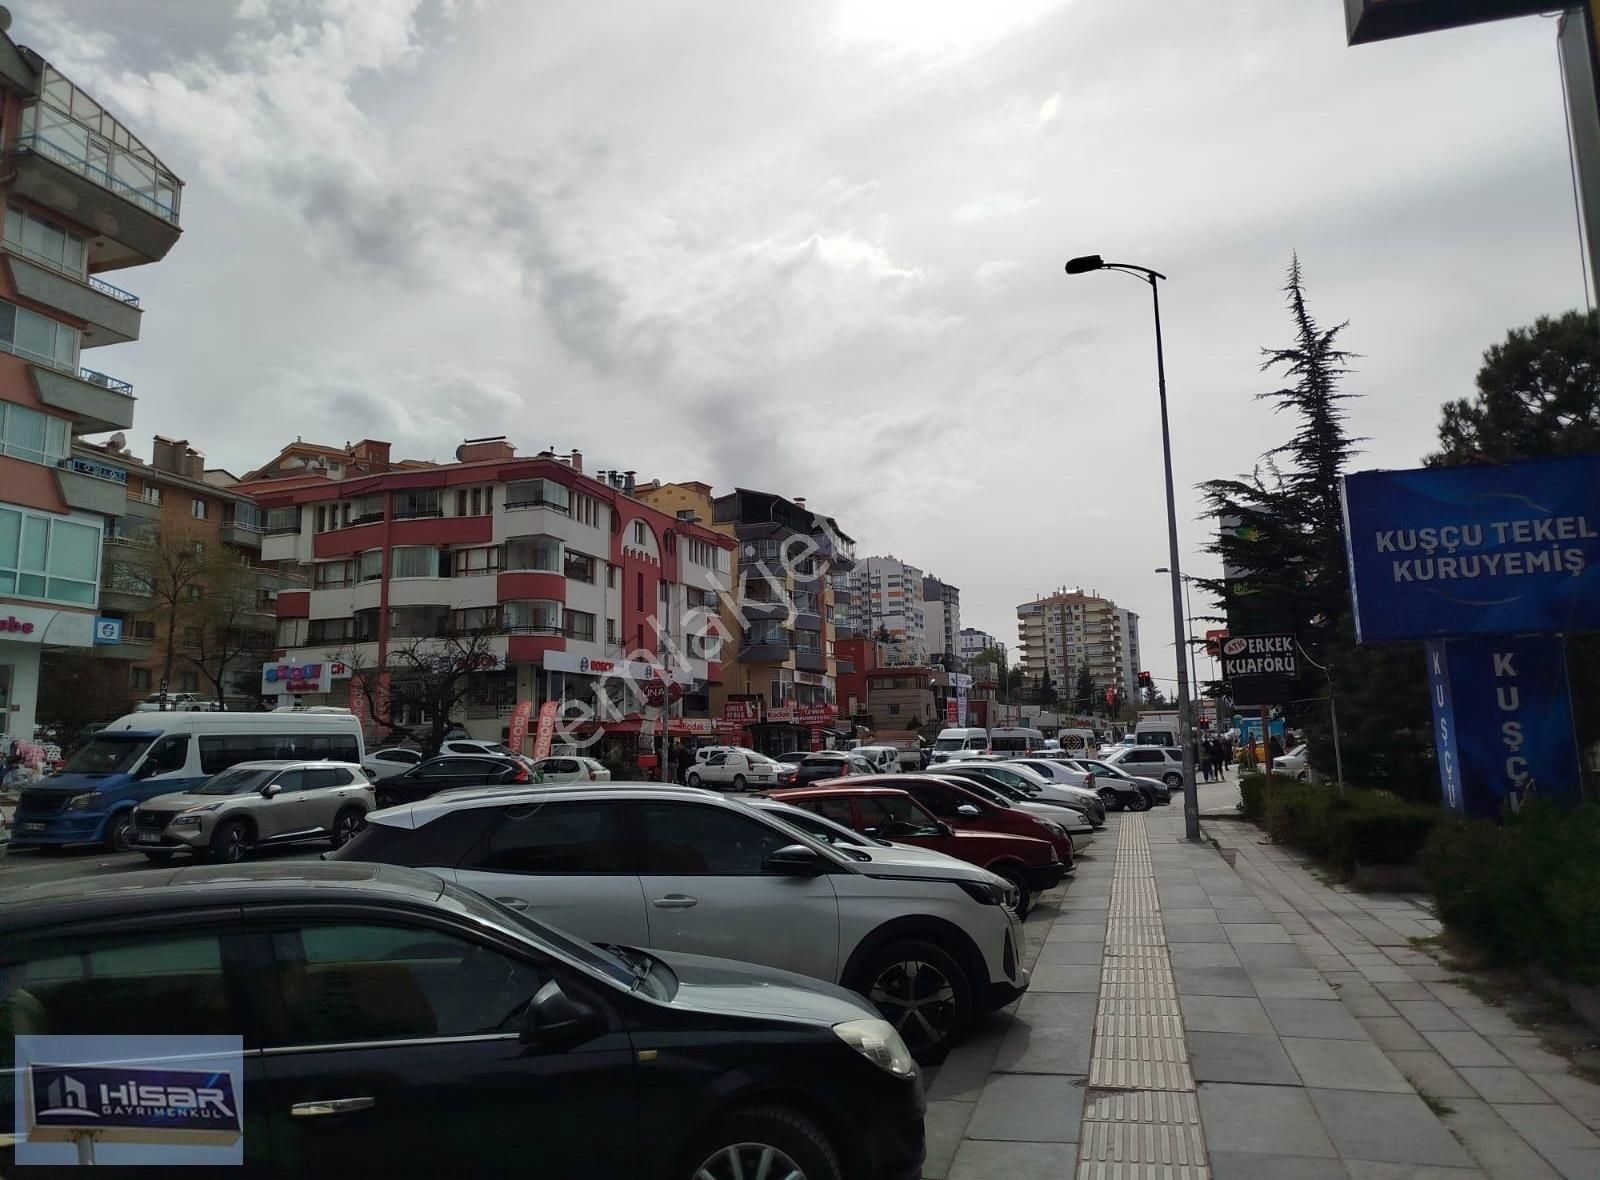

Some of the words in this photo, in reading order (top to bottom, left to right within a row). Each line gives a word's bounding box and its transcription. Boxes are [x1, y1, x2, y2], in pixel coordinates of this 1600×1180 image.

[1375, 523, 1483, 554] KUŞÇU
[1490, 516, 1598, 545] TEKEL
[1393, 543, 1586, 583] KURUYEMİŞ
[1248, 637, 1293, 654] ERKEK
[591, 660, 615, 672] BOSCH
[1226, 653, 1295, 674] KUAFÖRÜ
[1432, 652, 1456, 809] KUŞÇU
